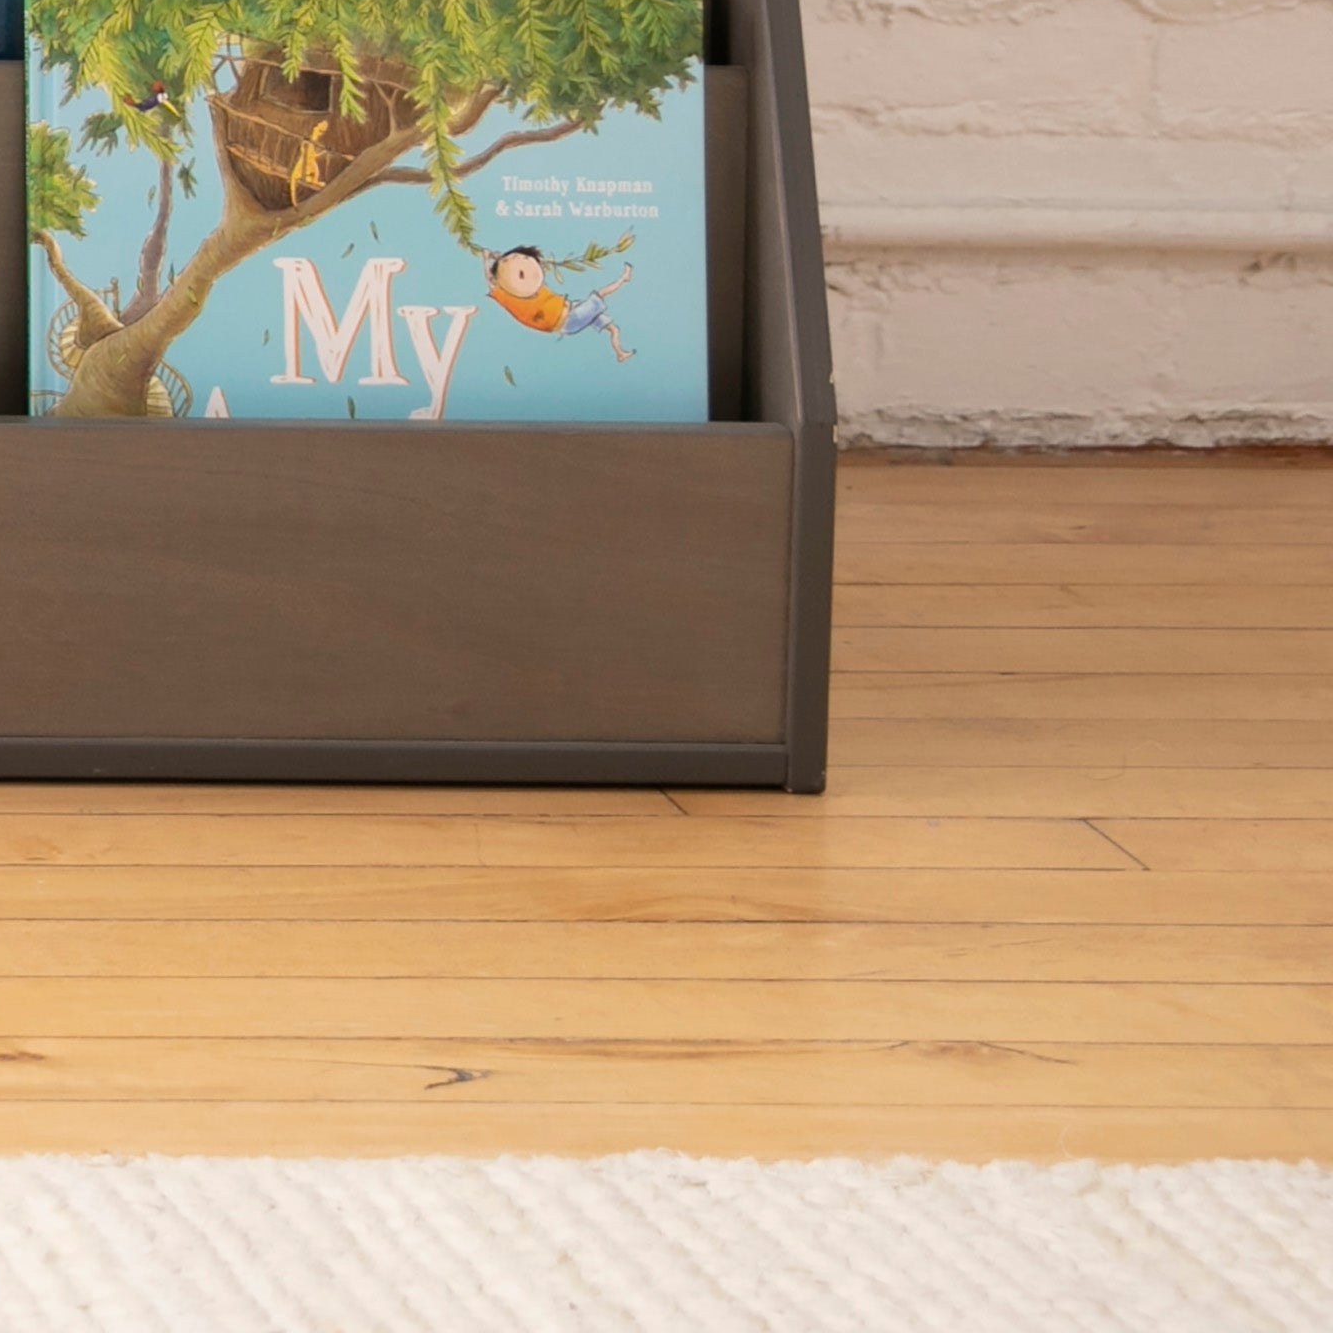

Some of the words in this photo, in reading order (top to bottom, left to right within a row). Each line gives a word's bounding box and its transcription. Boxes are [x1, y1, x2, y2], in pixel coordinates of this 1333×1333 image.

[501, 175, 569, 196] Timothy
[576, 176, 653, 197] Knapman
[495, 200, 509, 217] &
[514, 200, 562, 217] Sarah
[569, 201, 660, 218] Warburton
[270, 256, 478, 419] My
